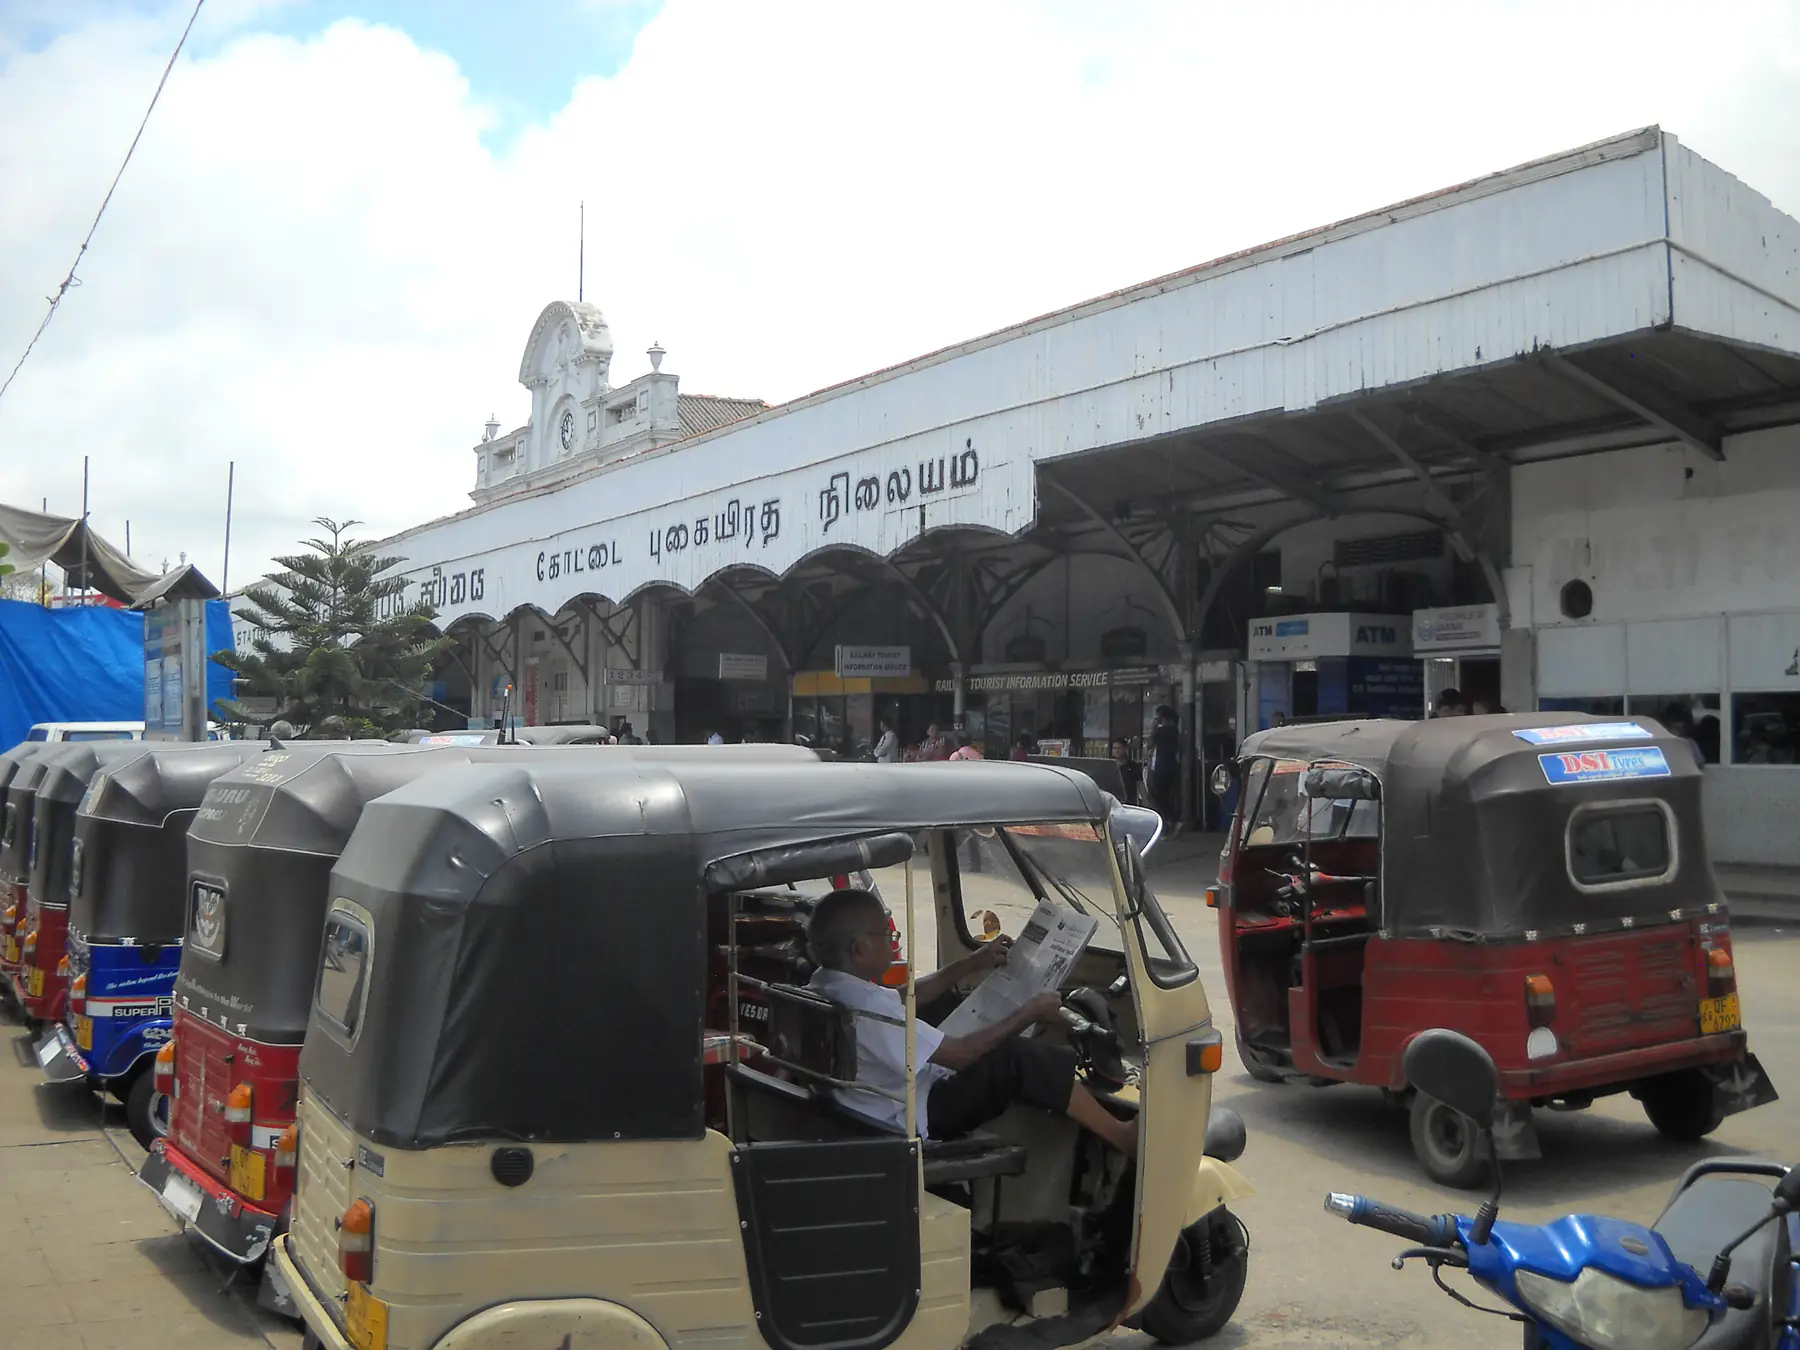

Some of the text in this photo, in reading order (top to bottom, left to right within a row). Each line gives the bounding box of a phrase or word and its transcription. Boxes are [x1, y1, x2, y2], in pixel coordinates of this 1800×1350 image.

[649, 499, 781, 564] புகையிரத
[819, 438, 979, 532] நிலையம்
[1252, 624, 1273, 637] ATM
[1355, 625, 1397, 645] ATM
[844, 663, 883, 671] INFORMATION
[970, 676, 1006, 690] TOURIST
[1006, 674, 1068, 689] INFORMATION
[1069, 671, 1108, 687] SERVICE
[1557, 751, 1646, 774] DSI Tyres
[114, 1007, 156, 1017] SUPER
